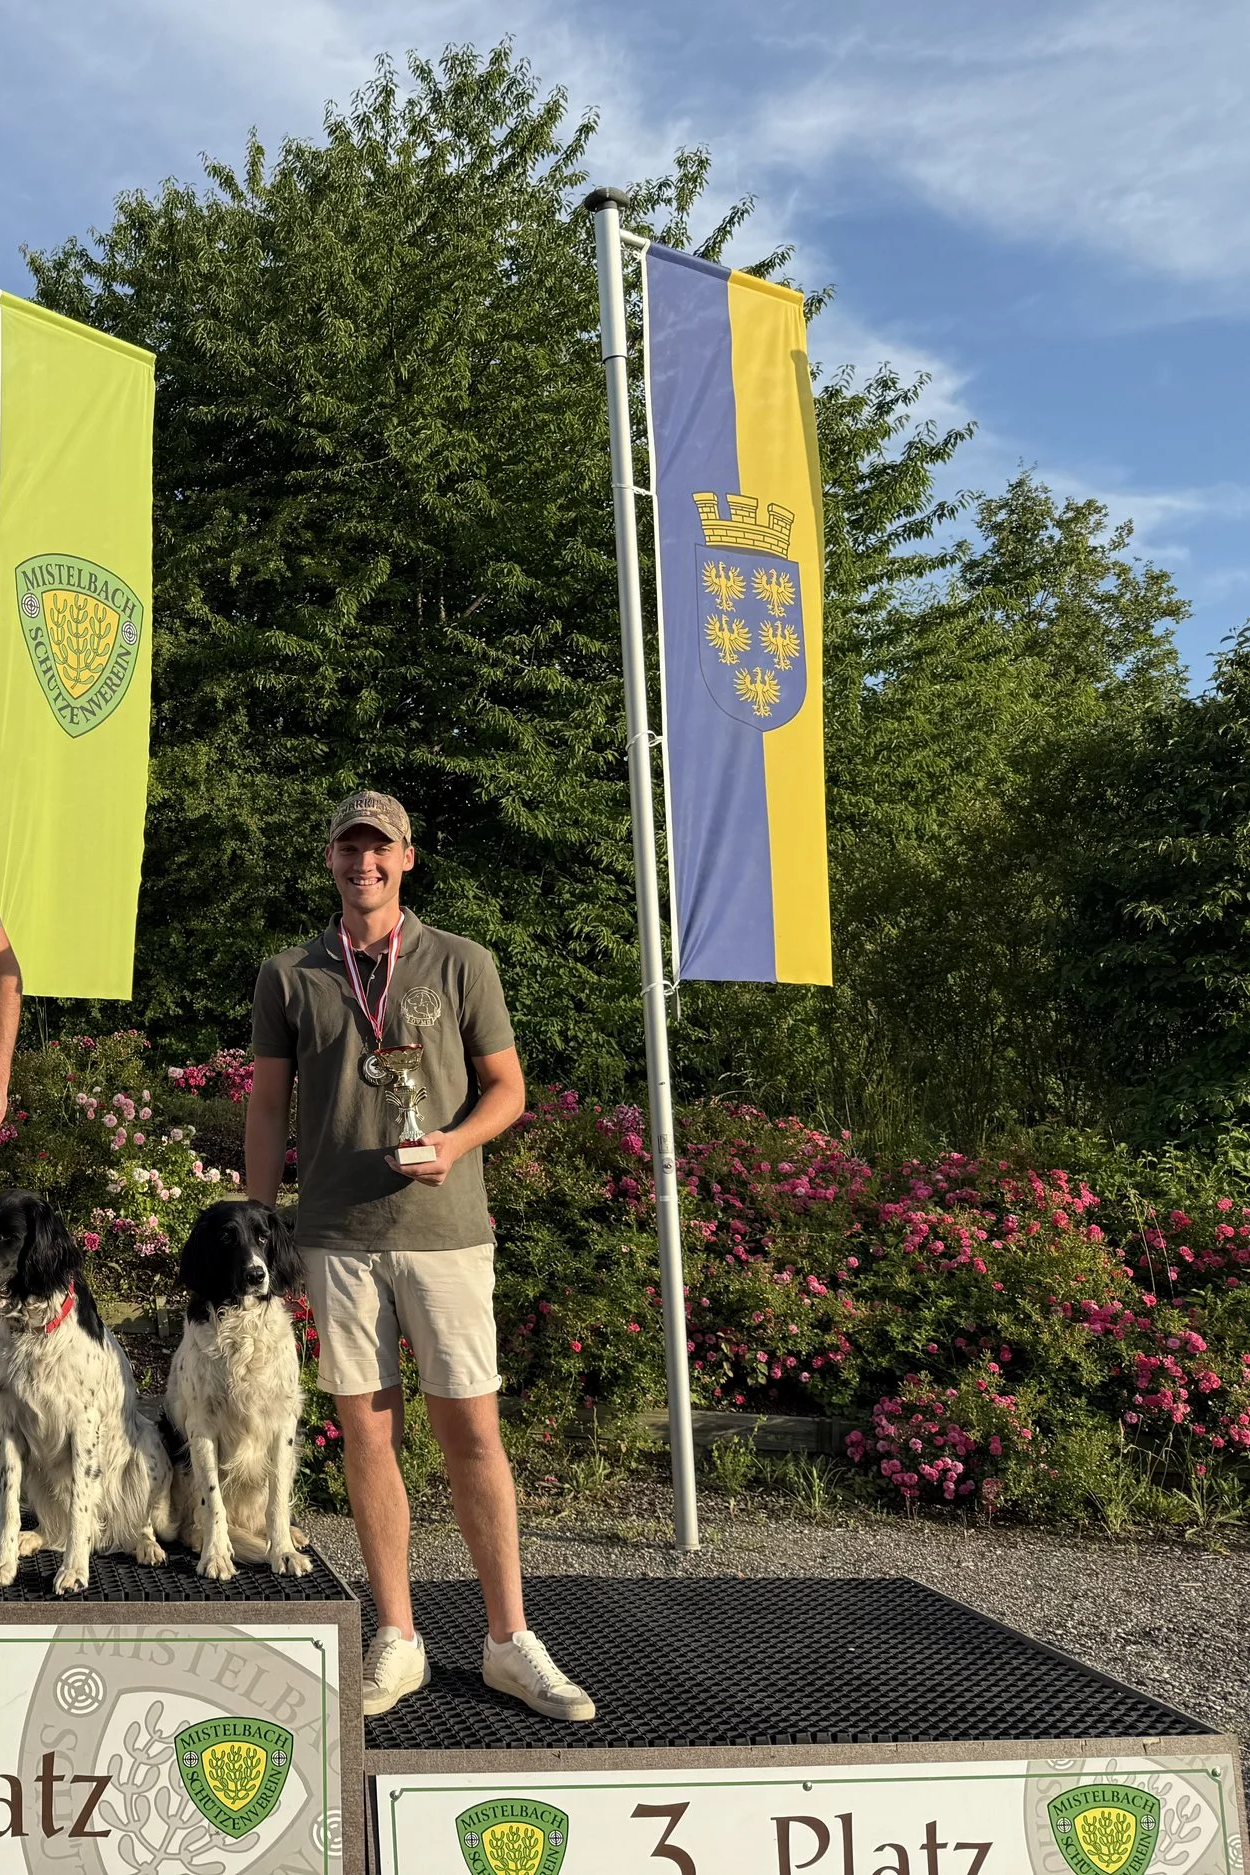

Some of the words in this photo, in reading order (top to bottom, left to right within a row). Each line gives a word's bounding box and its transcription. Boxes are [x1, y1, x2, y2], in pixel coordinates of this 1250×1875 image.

[21, 563, 137, 620] MISTELBACH
[29, 626, 132, 725] SCHÜTZENVEREIN
[179, 1723, 289, 1750] MISTELBACH
[186, 1768, 283, 1831] SCHÜTZENVEREIN
[460, 1804, 565, 1831] MISTELBACH
[1052, 1790, 1156, 1817] MISTELBACH
